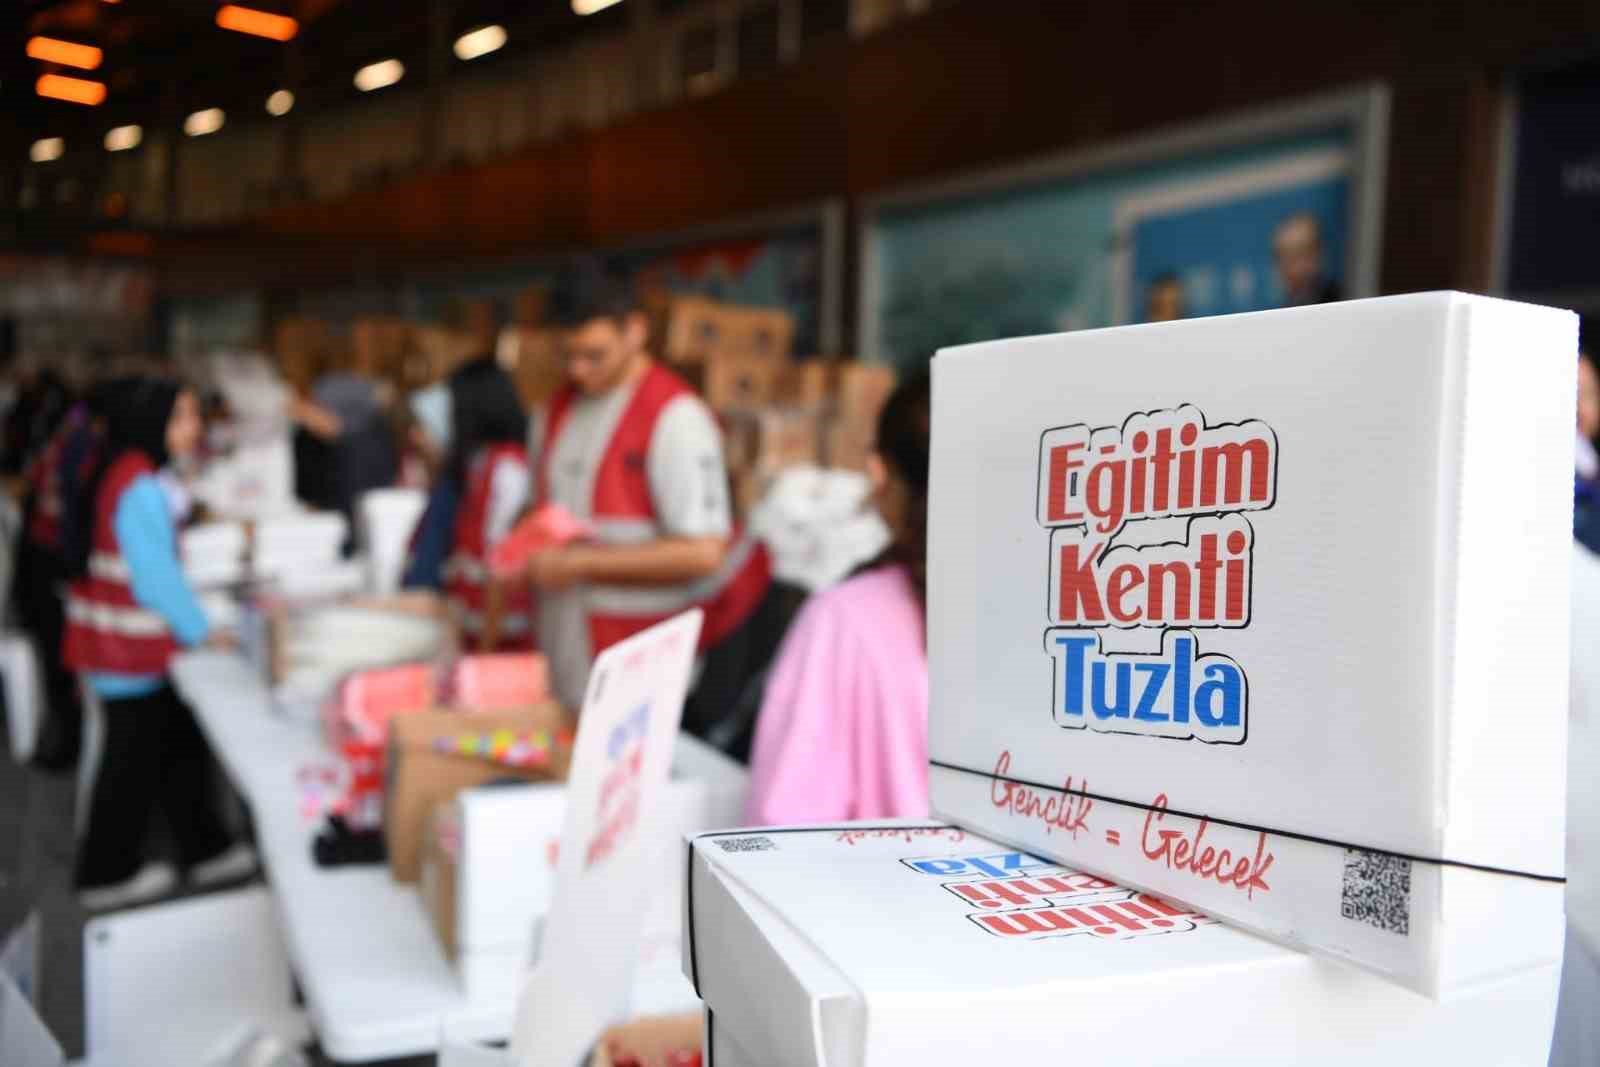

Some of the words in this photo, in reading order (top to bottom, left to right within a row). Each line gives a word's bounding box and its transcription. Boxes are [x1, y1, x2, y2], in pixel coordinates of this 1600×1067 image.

[1047, 422, 1270, 534] Eğitim
[1058, 530, 1247, 623] Kenti
[1055, 636, 1242, 728] Tuzla
[912, 852, 1028, 878] zla
[990, 750, 1094, 840] Gençlik
[1140, 792, 1275, 901] Gelecek
[953, 872, 1120, 909] enti
